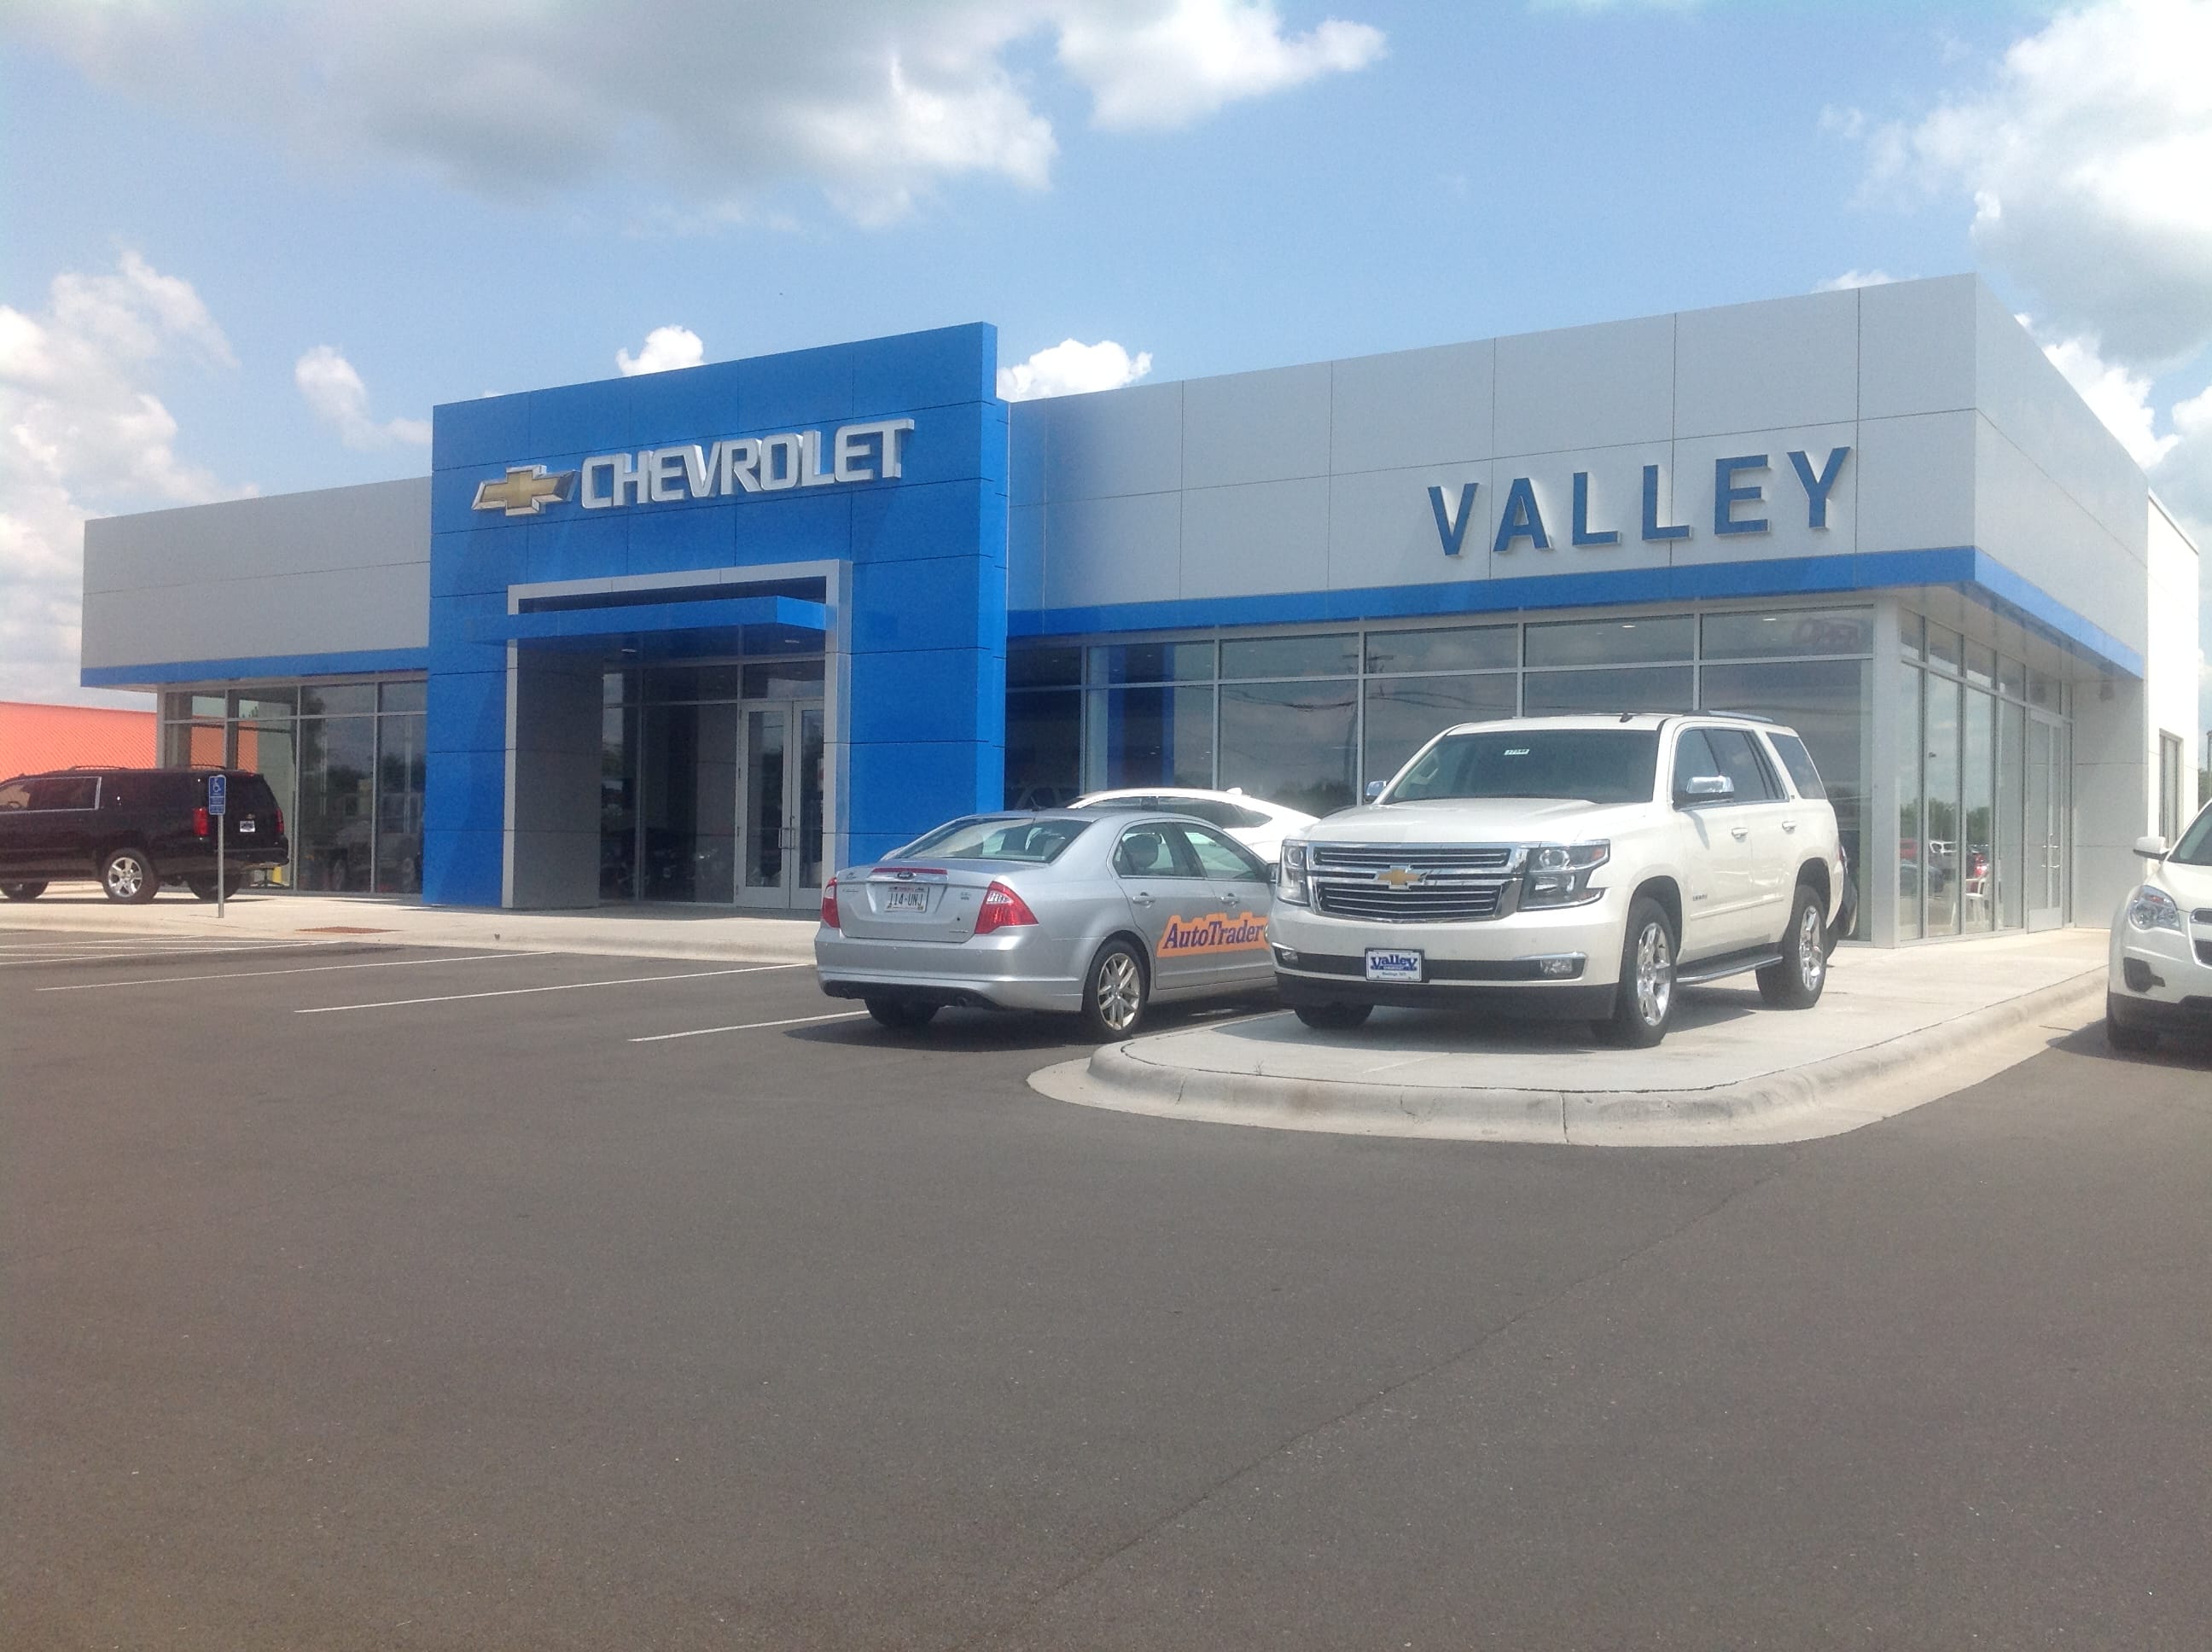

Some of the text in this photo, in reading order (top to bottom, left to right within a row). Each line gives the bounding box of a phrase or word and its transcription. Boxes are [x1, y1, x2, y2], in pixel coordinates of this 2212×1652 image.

[581, 418, 915, 509] CHEVROLET
[1428, 446, 1851, 556] VALLEY
[1162, 920, 1264, 949] AutoTrader
